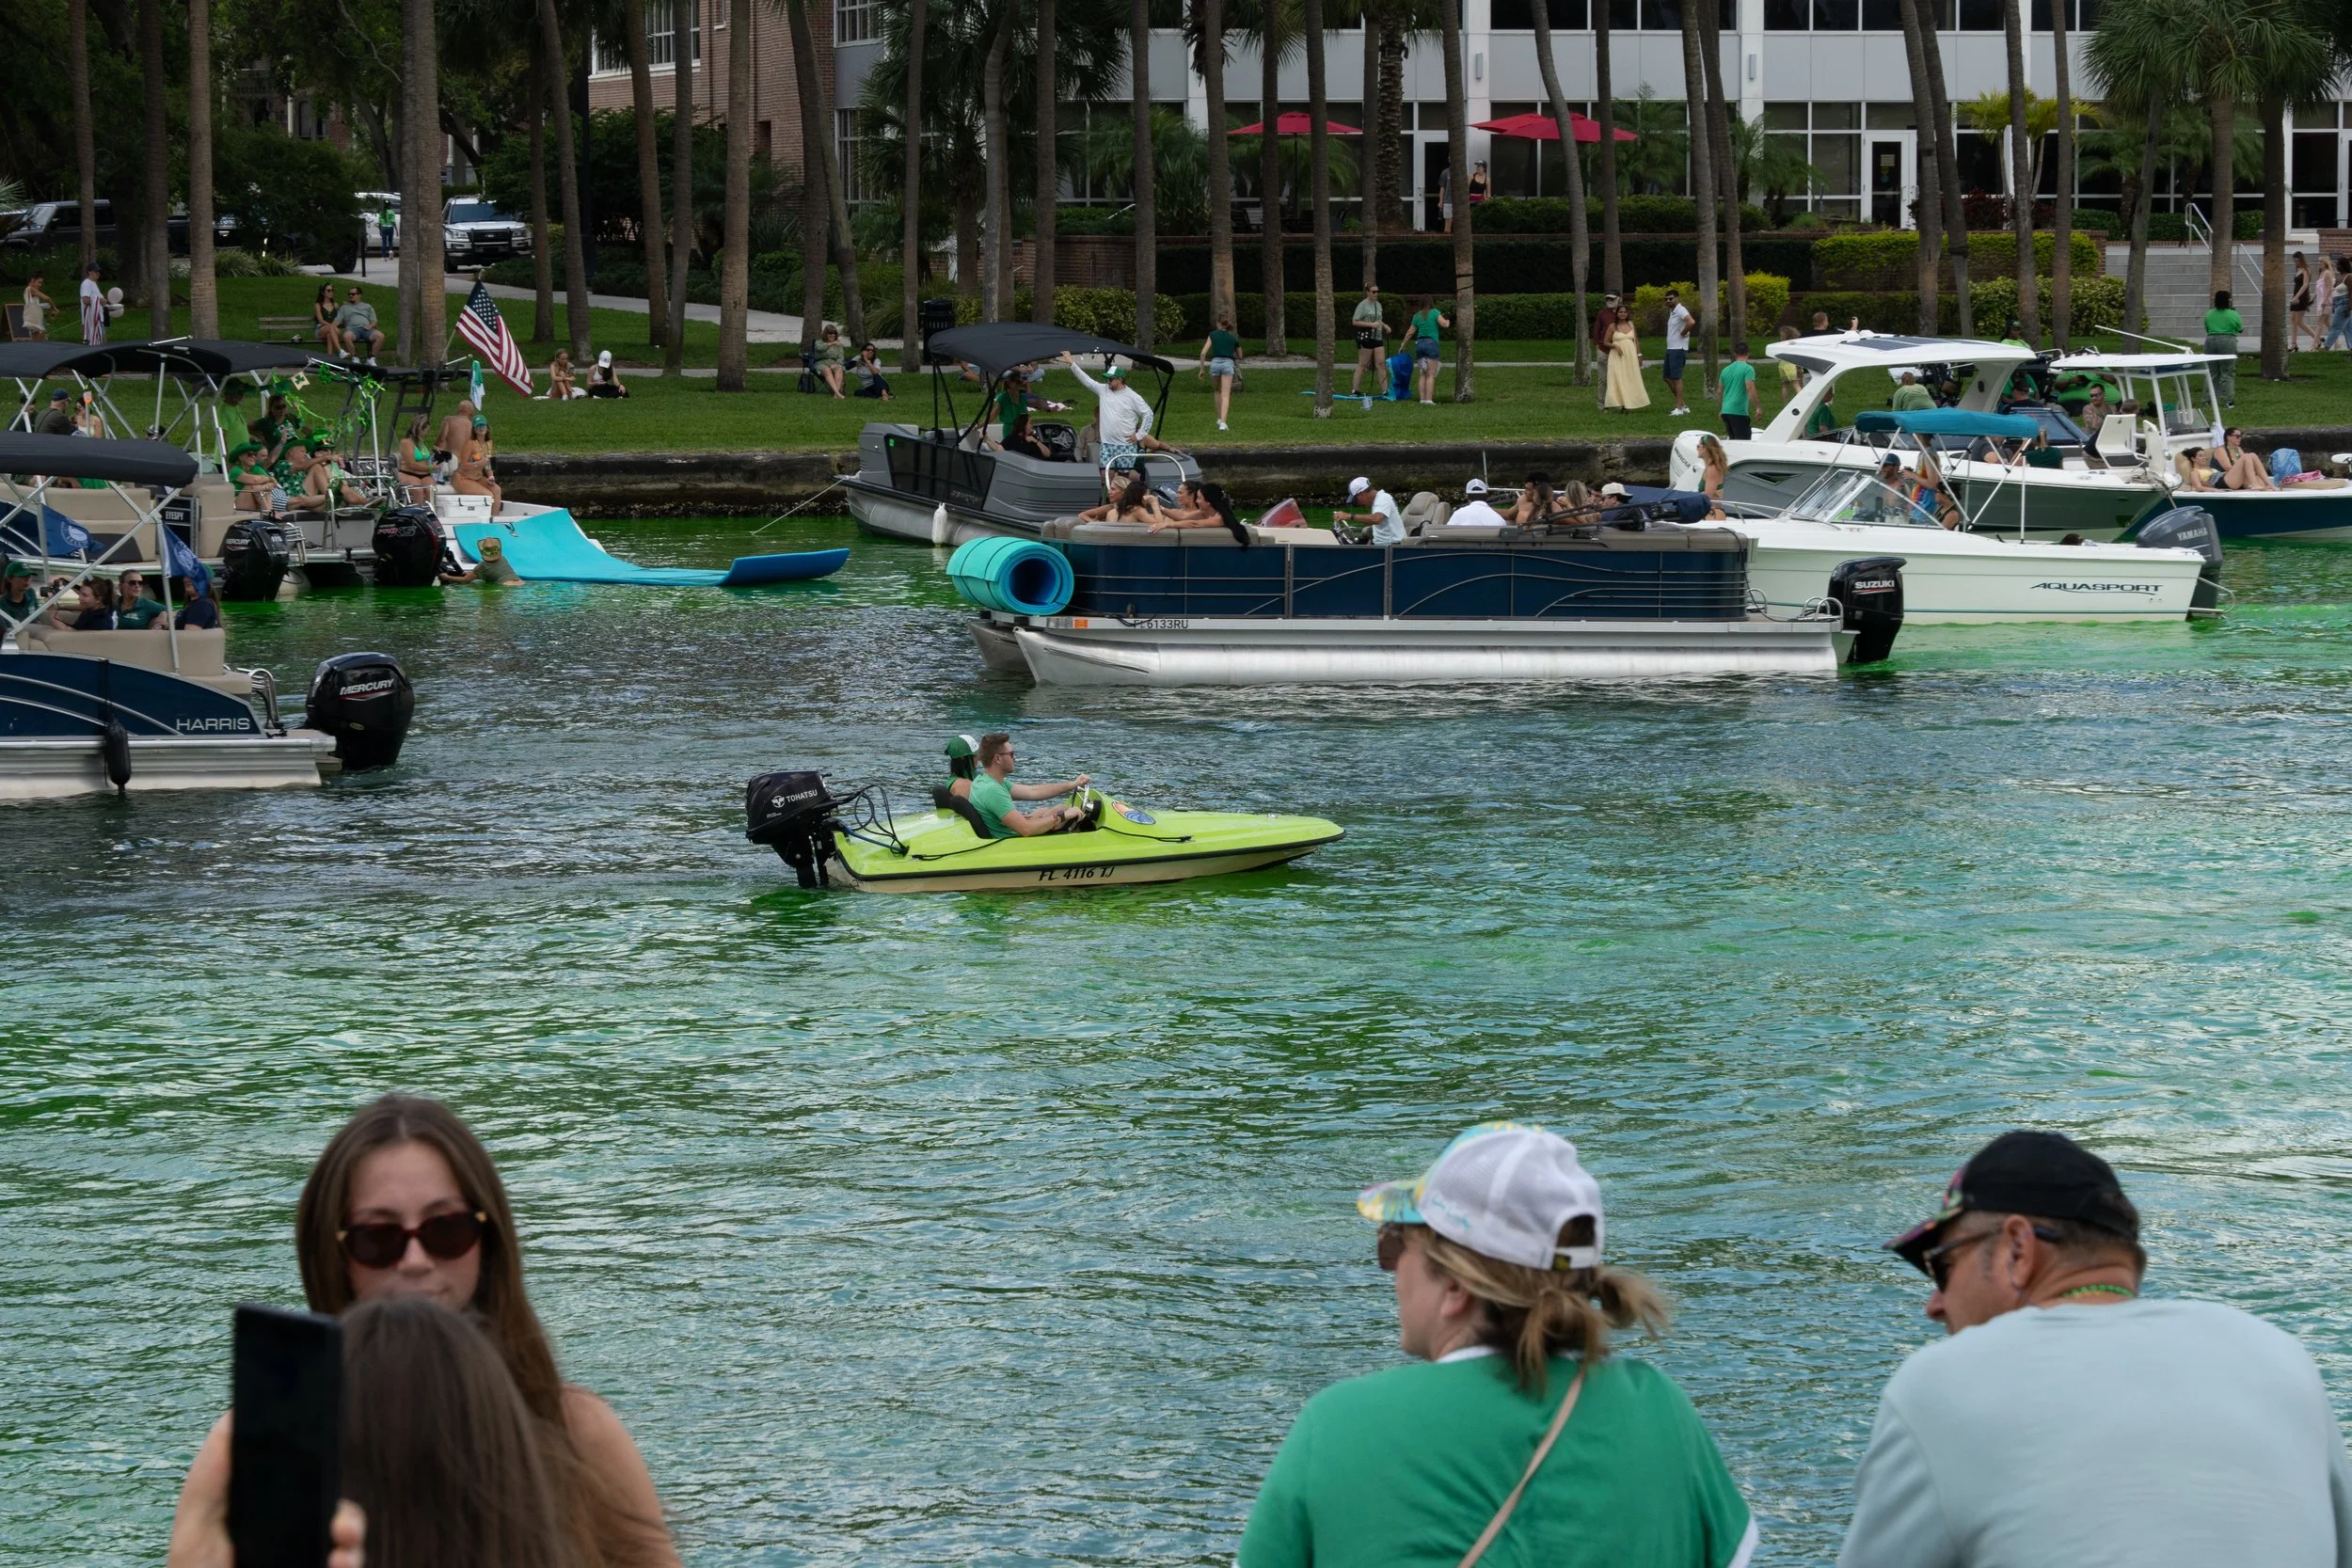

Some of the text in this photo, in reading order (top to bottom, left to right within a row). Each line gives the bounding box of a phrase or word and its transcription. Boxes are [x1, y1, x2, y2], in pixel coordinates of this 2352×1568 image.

[2176, 527, 2209, 542] YAMAHA
[1854, 579, 1895, 590] SUZUKI
[2030, 582, 2164, 593] AQUASPORT
[339, 678, 395, 695] MERCURY
[176, 718, 250, 731] HARRIS
[786, 789, 818, 803] TOHATSU
[1038, 870, 1058, 881] FL
[1063, 867, 1096, 879] 4116
